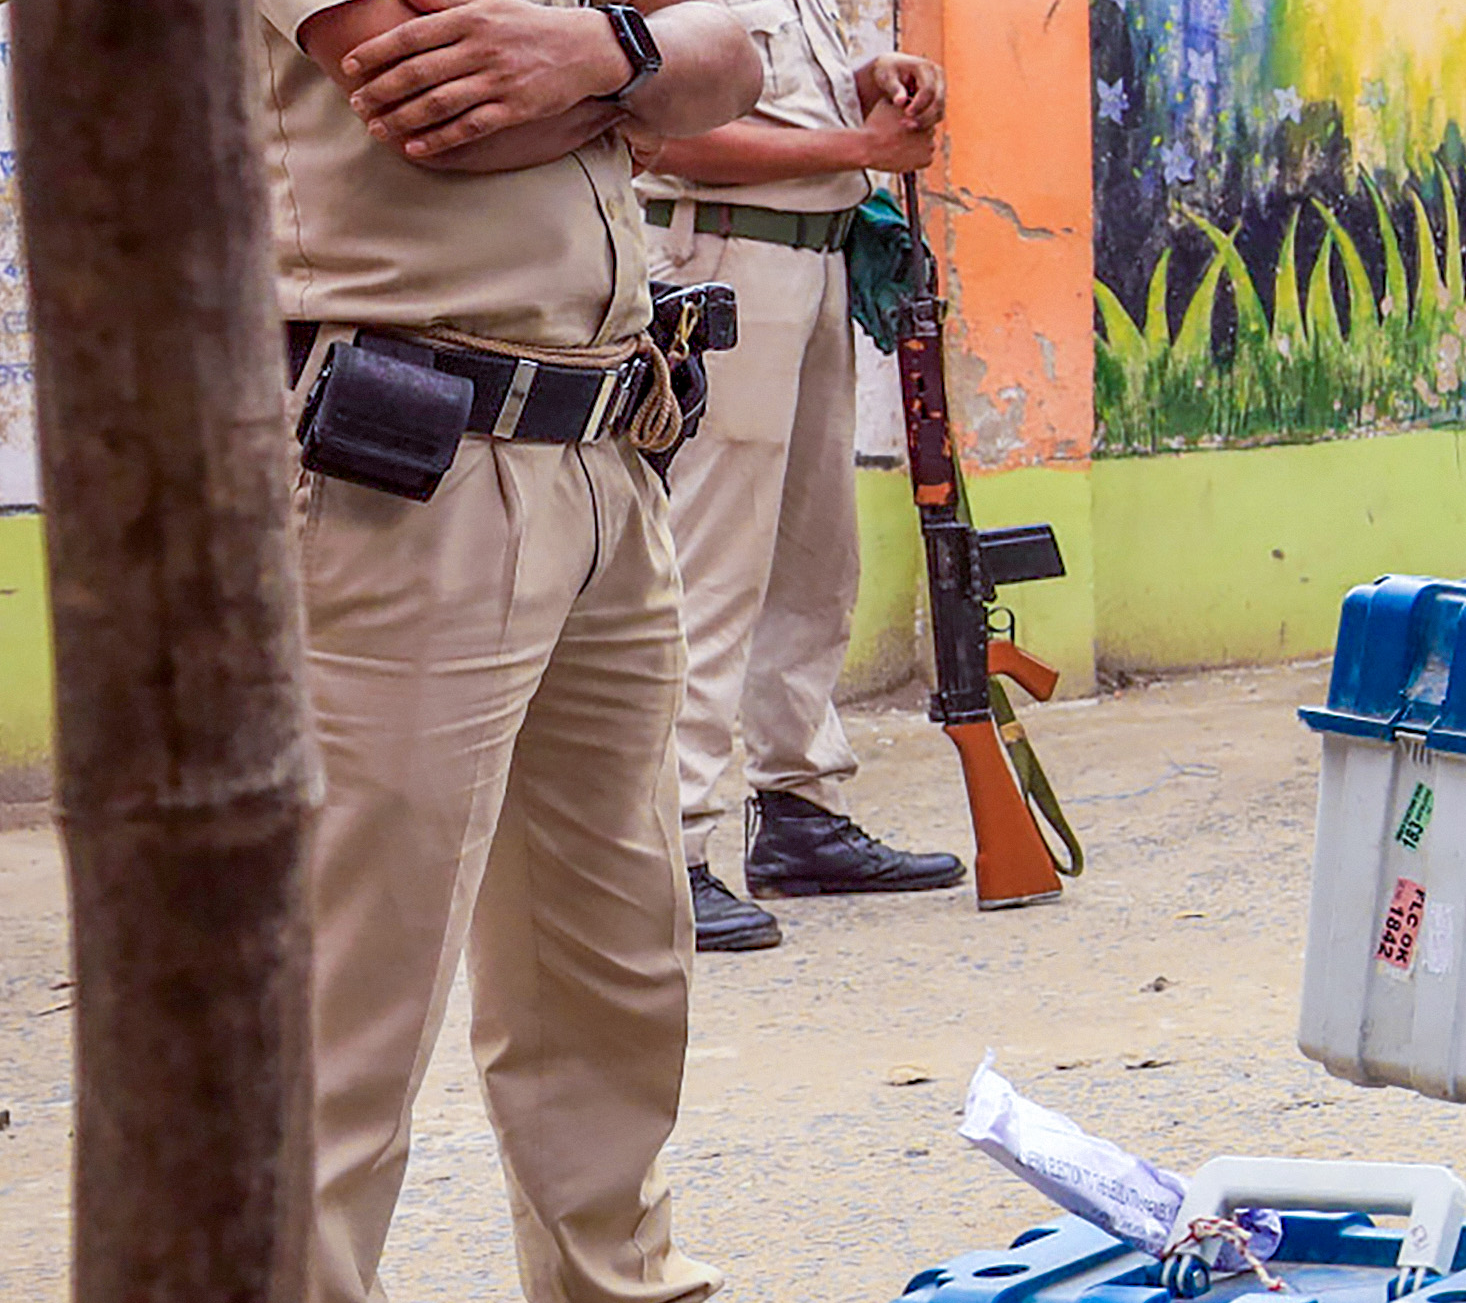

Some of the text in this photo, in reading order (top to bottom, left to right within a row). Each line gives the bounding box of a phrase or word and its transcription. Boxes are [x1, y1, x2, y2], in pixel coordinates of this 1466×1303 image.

[1401, 820, 1425, 849] 183
[1378, 905, 1404, 959] 1842
[1395, 888, 1427, 964] FLC OK
